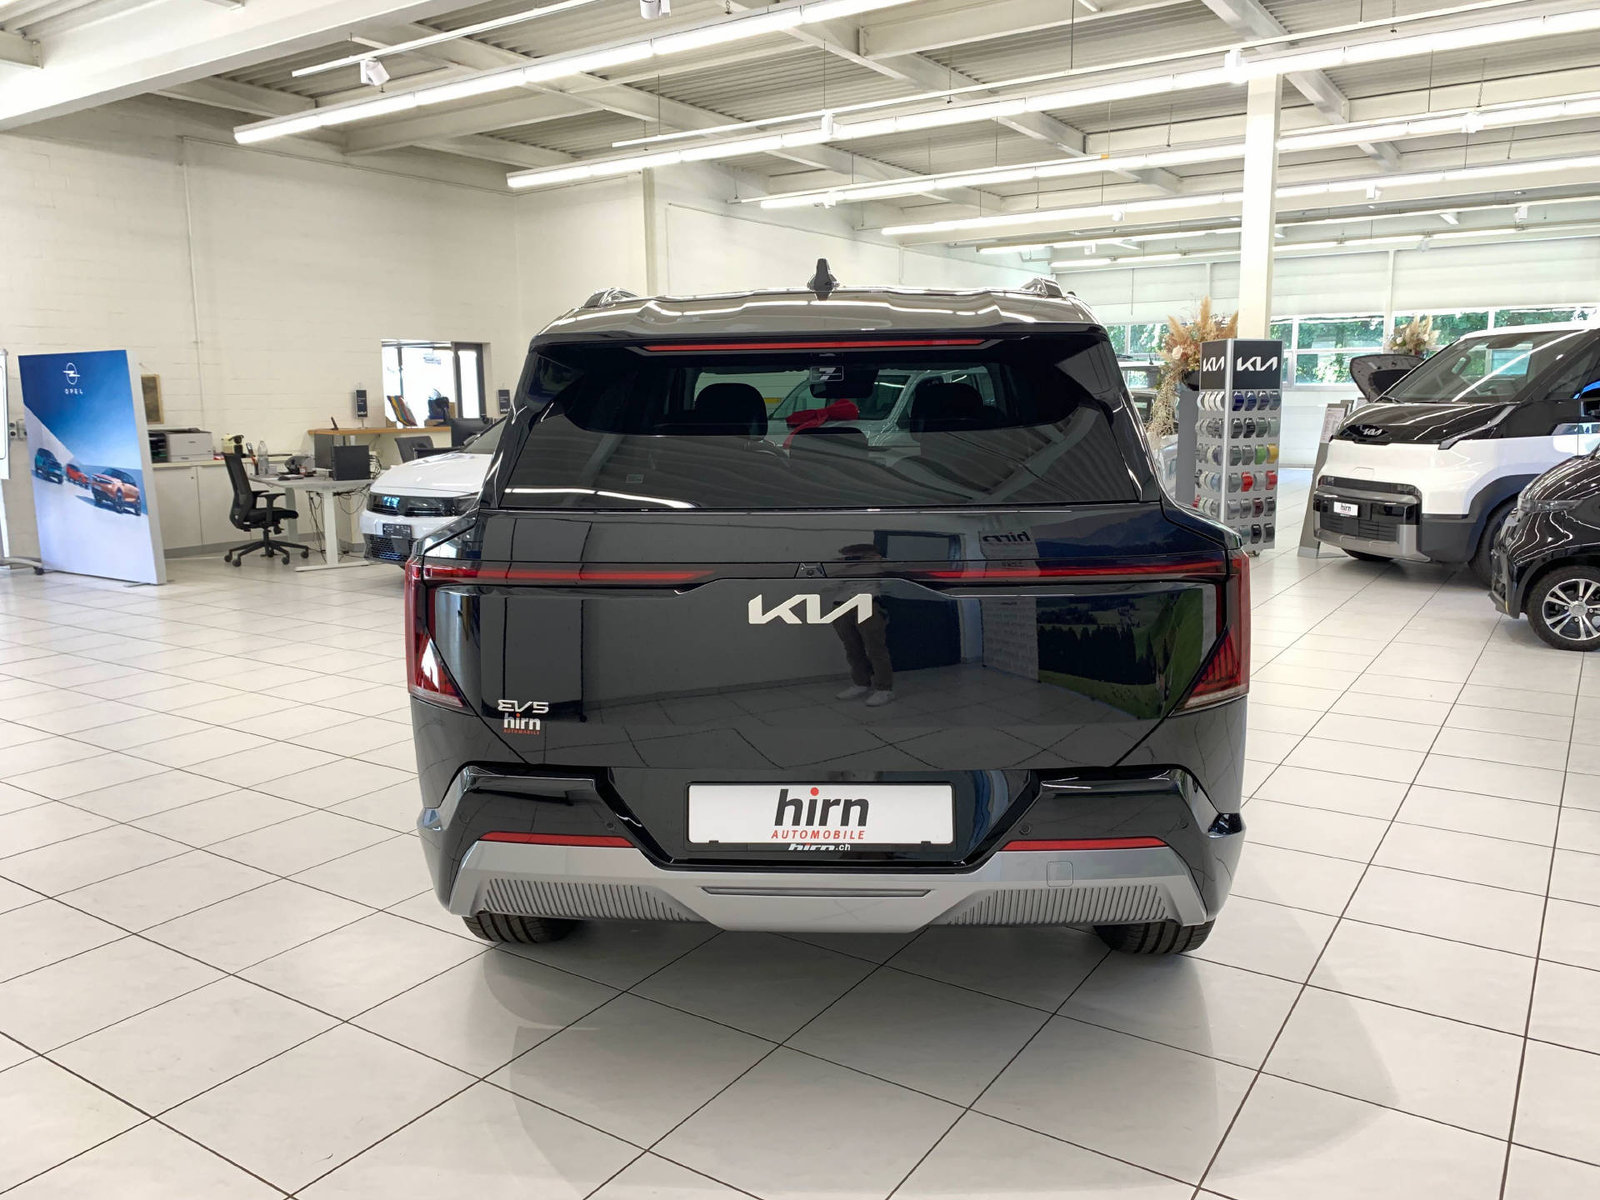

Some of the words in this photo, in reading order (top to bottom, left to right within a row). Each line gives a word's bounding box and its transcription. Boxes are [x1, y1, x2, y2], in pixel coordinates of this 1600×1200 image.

[1203, 356, 1225, 372] KIA
[1236, 356, 1278, 372] KIA
[1363, 428, 1383, 436] KIA
[748, 594, 873, 624] KIA
[497, 699, 549, 714] EV5
[503, 712, 541, 730] hirn
[774, 787, 869, 827] hirn
[771, 830, 865, 840] AUTOMOBILE
